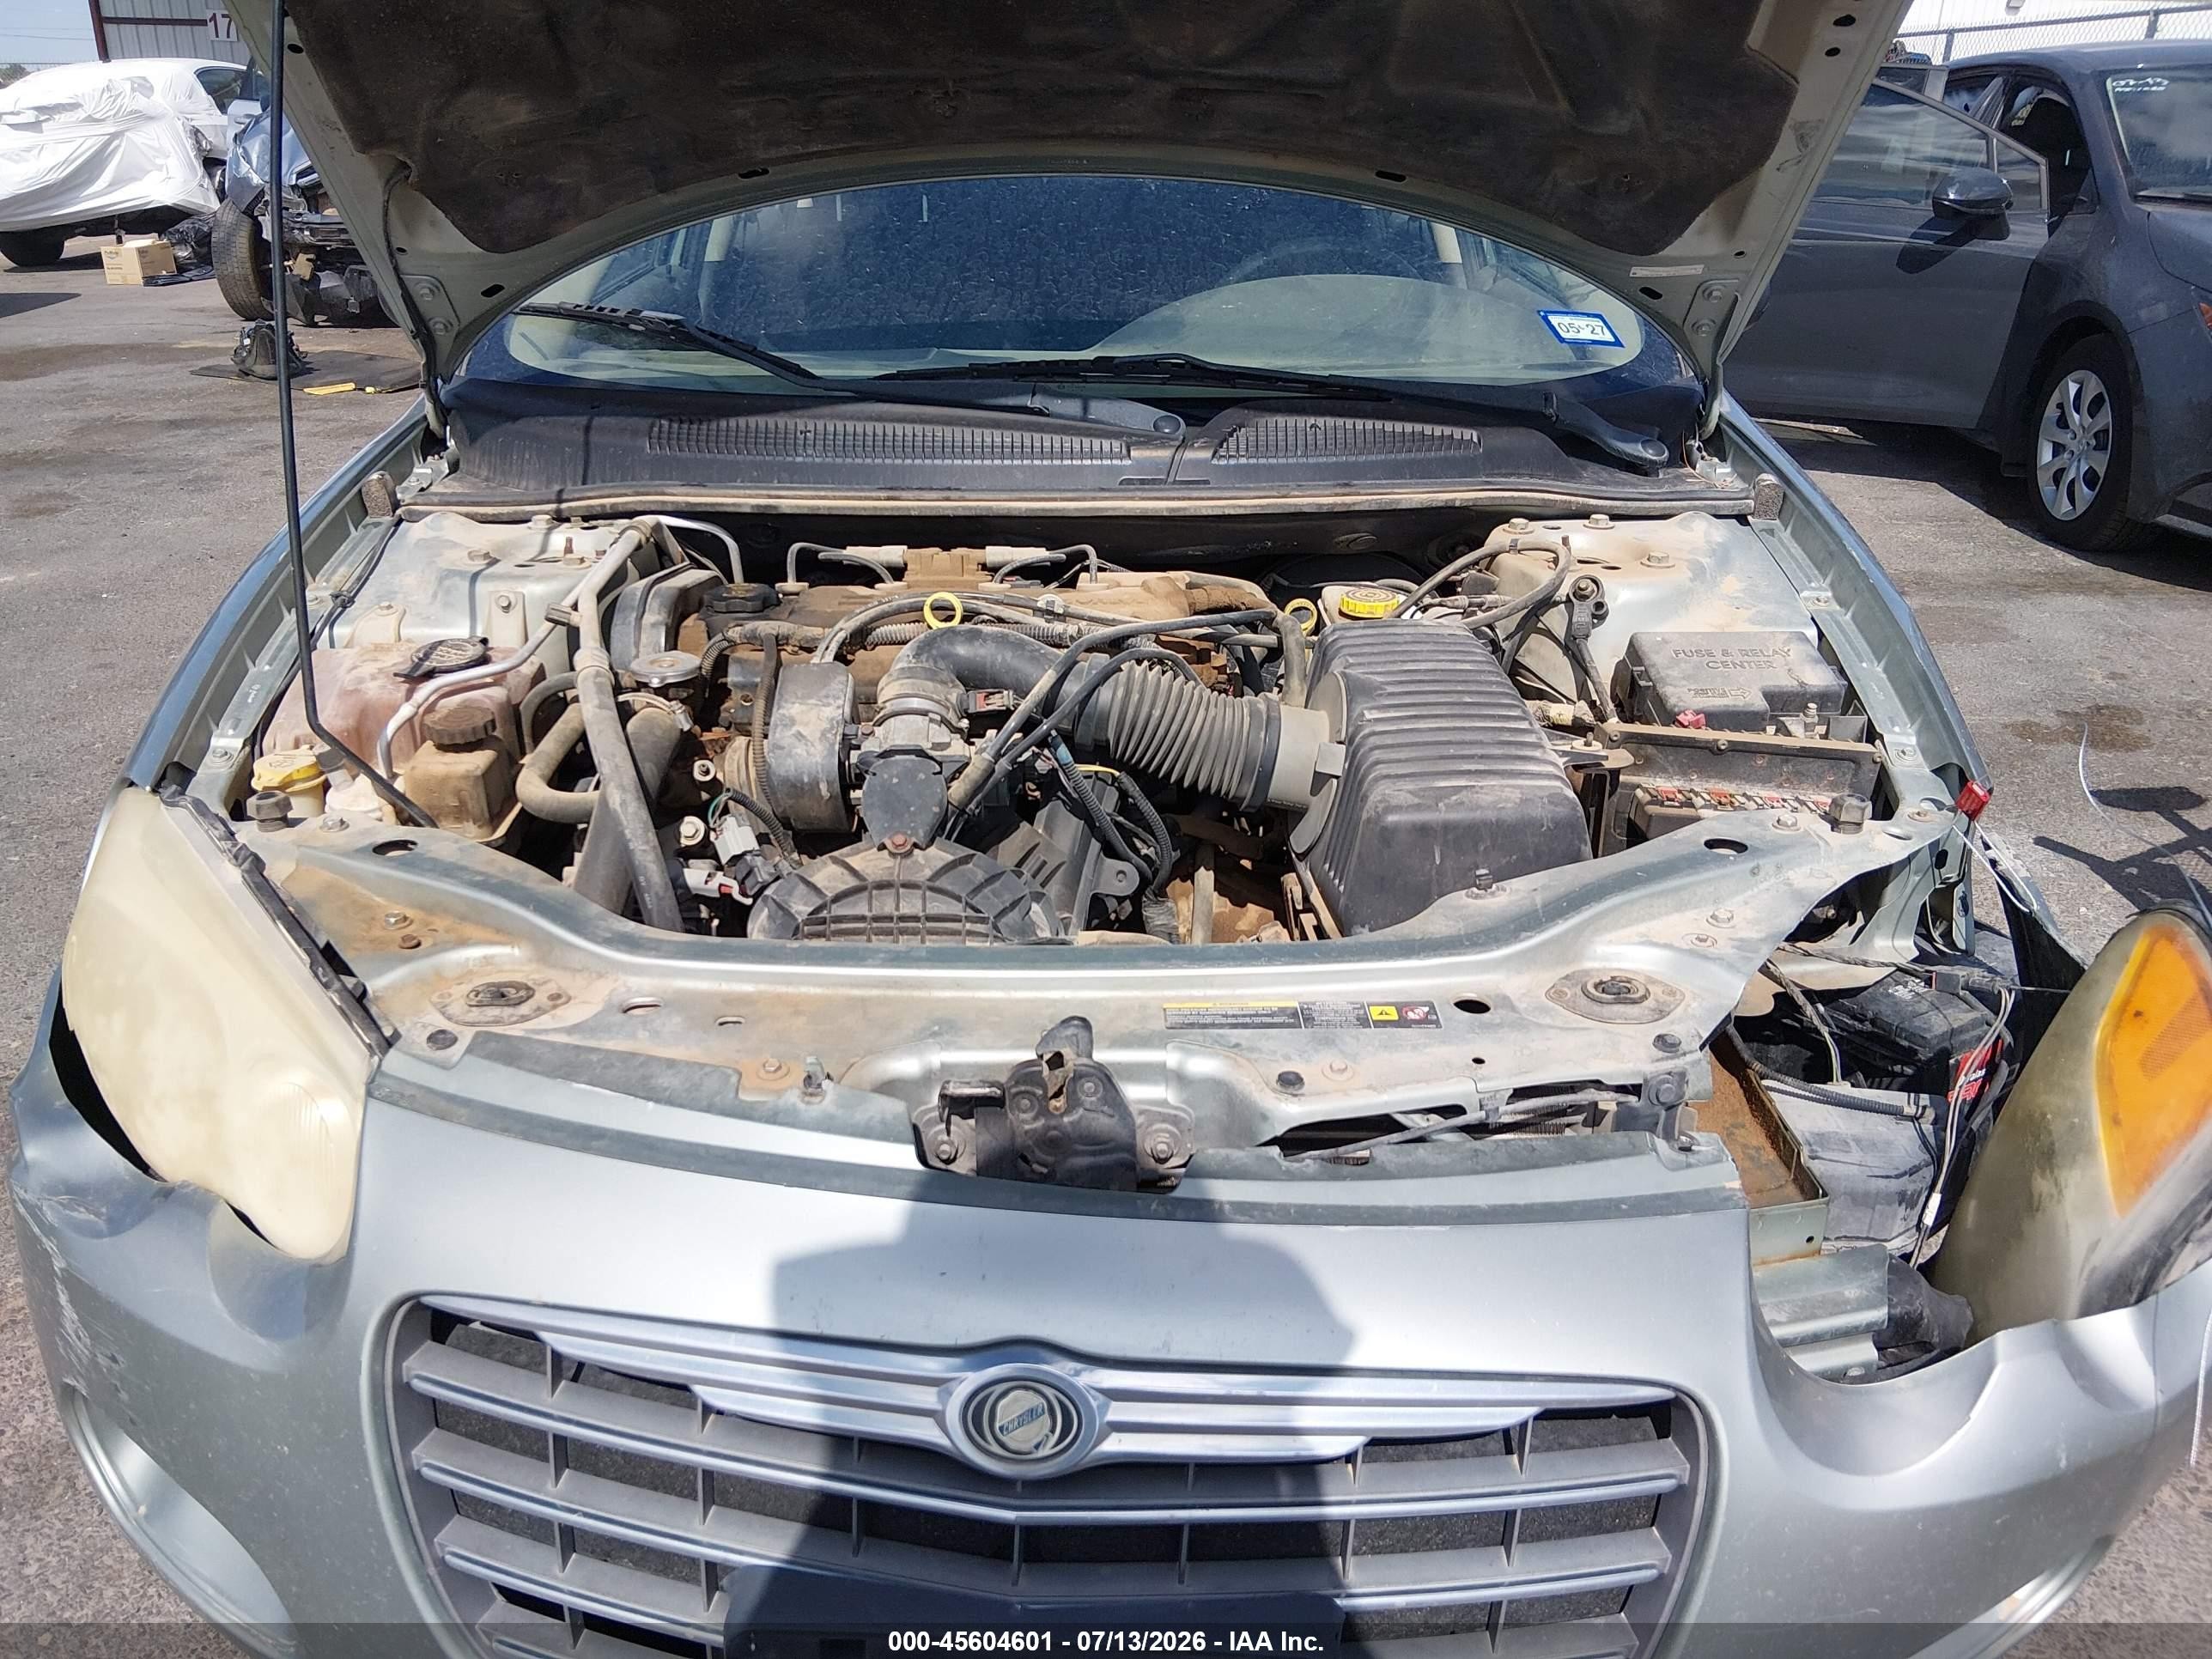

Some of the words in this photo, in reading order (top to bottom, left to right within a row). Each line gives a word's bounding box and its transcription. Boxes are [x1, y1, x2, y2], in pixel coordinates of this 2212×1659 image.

[209, 12, 233, 39] 17
[1557, 322, 1580, 334] 05
[1586, 324, 1606, 336] 27
[1672, 648, 1717, 659] FUSE
[1721, 648, 1735, 658] &
[1737, 647, 1791, 657] RELAY
[1705, 660, 1778, 669] CENTER
[1002, 1403, 1045, 1436] CHRYSLER
